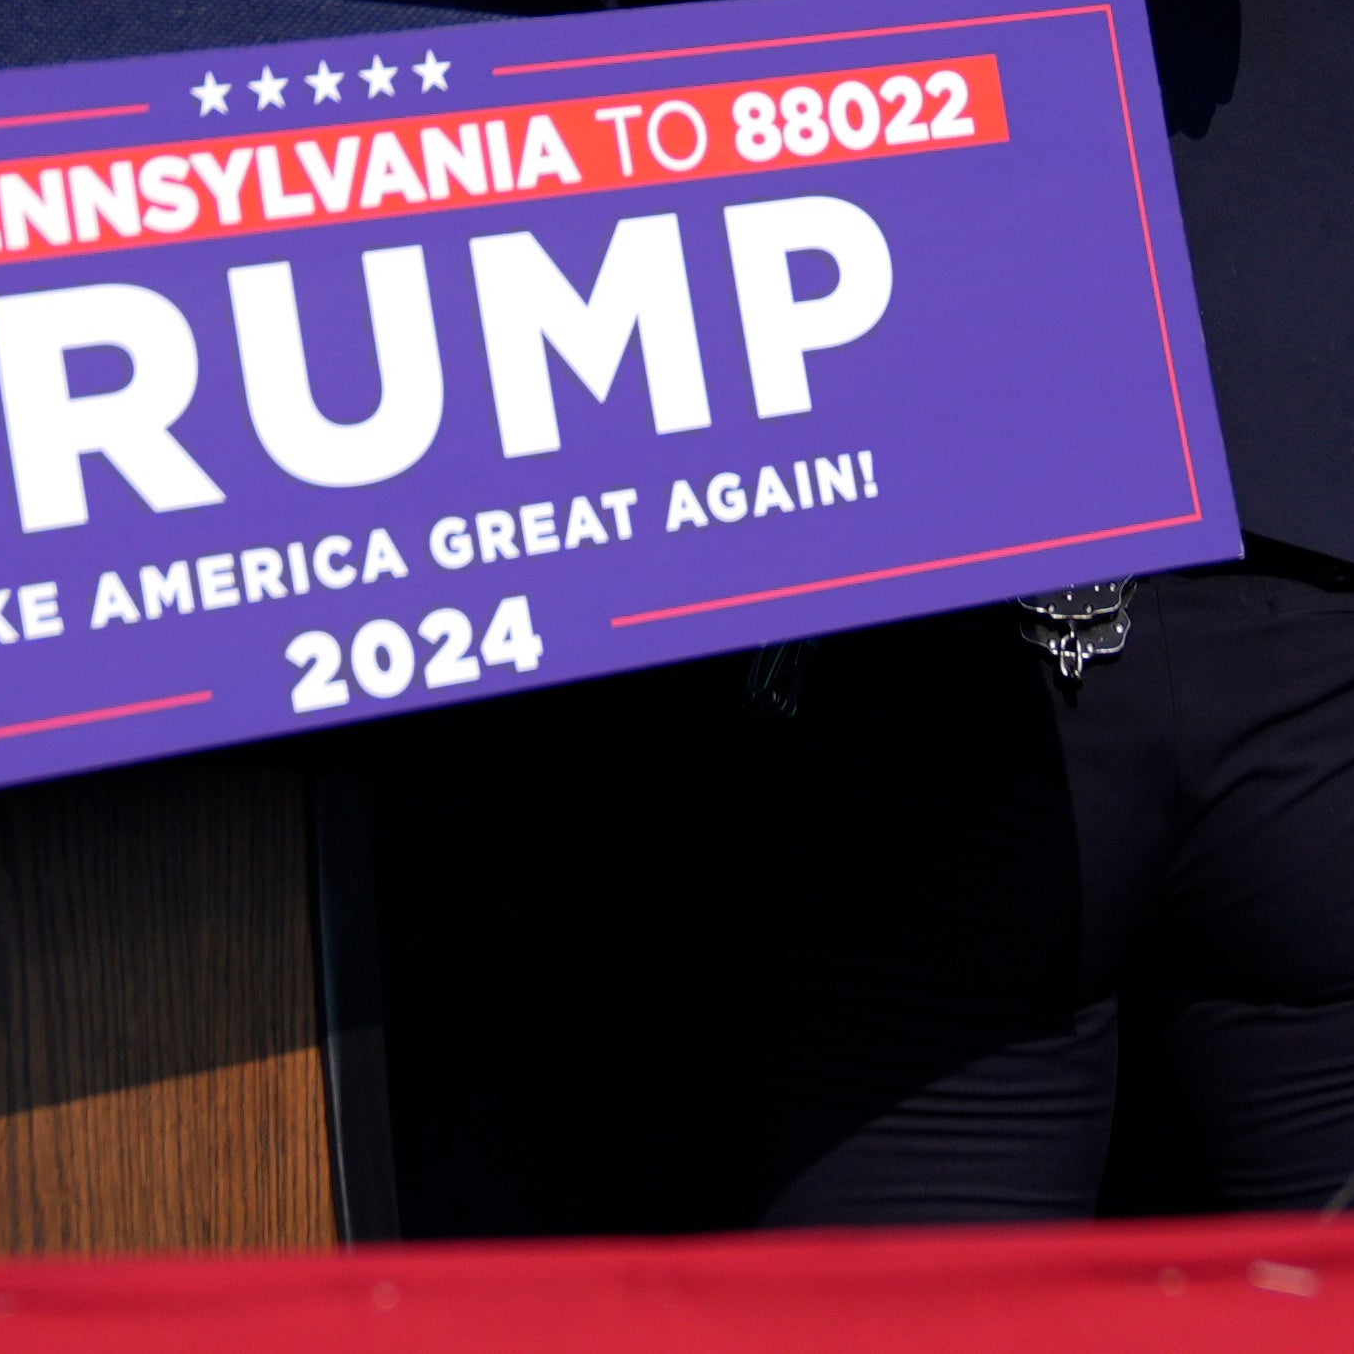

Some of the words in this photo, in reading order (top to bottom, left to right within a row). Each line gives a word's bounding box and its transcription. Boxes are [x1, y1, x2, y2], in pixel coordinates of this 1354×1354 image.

[594, 99, 709, 178] TO
[731, 69, 976, 163] 88022
[89, 527, 410, 630] AMERICA
[428, 487, 639, 571] GREAT
[665, 449, 880, 533] AGAIN!
[284, 594, 545, 714] 2024
